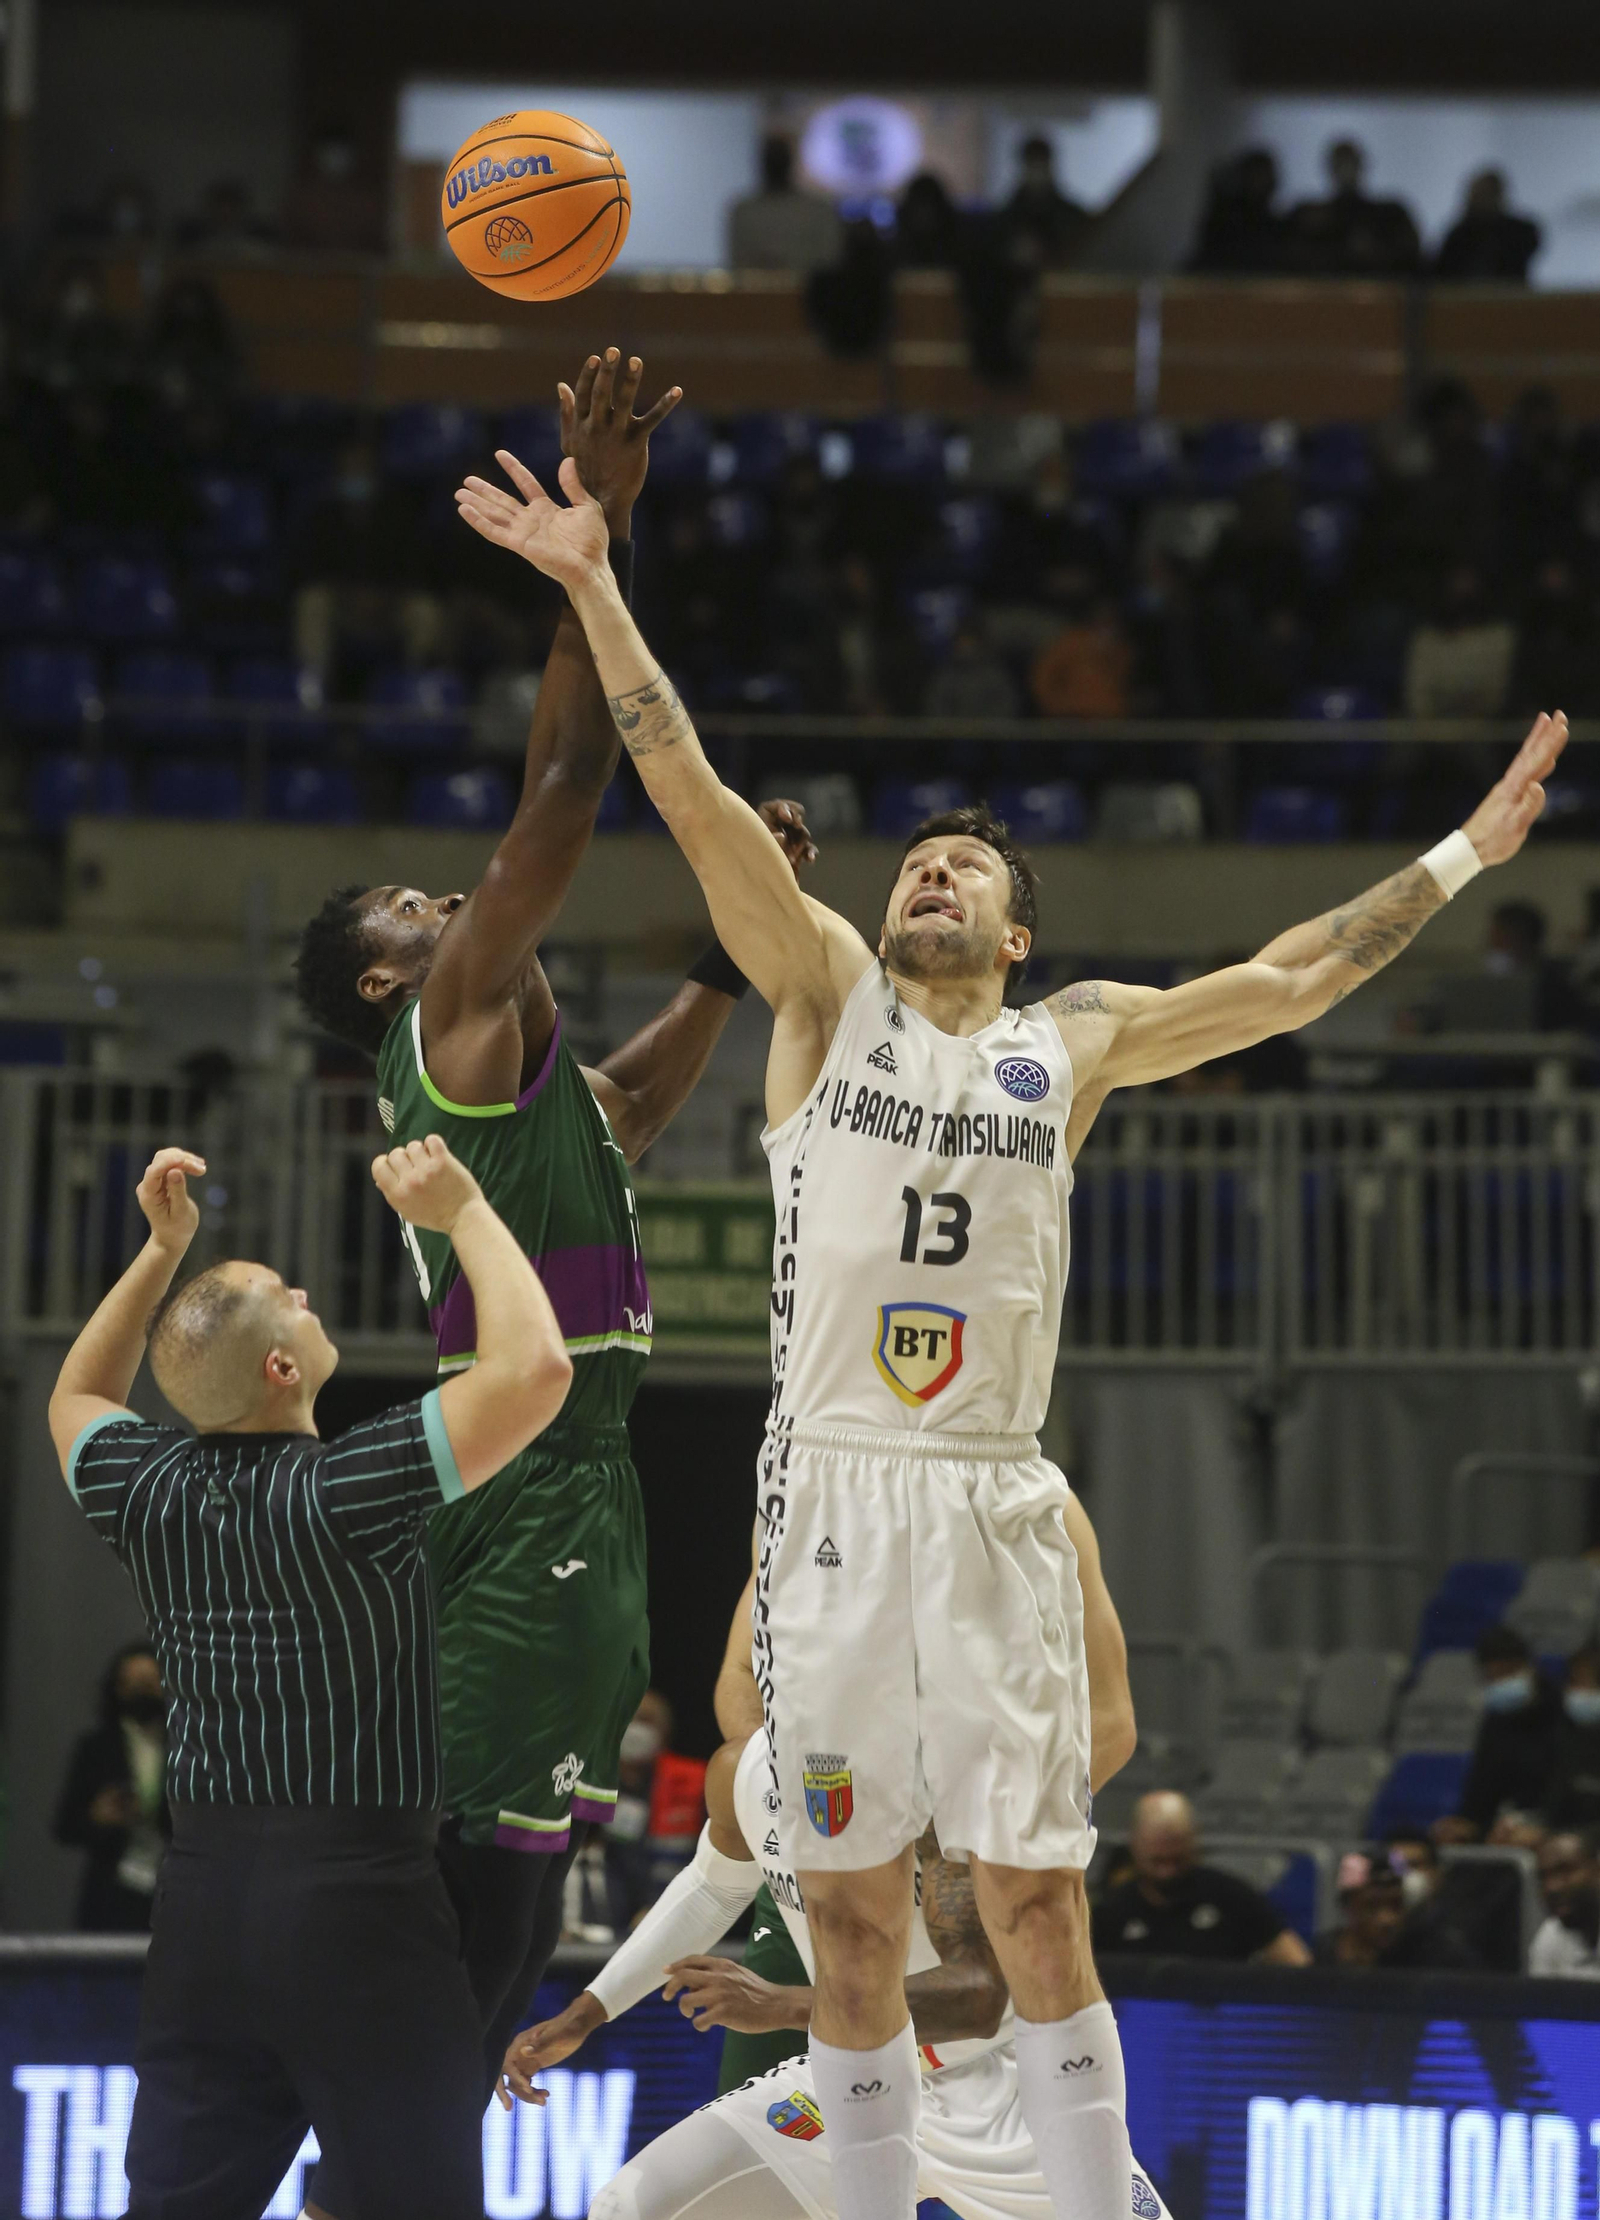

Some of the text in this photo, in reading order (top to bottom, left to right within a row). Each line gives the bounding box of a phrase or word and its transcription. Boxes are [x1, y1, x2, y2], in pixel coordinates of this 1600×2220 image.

[446, 154, 554, 209] Wilson
[533, 264, 586, 295] CHAMPIONS
[866, 1053, 899, 1076] PEAK
[830, 1079, 1056, 1171] U-BANCA TANSILVANIA
[899, 1185, 972, 1267] 13
[893, 1325, 947, 1361] BT
[814, 1556, 843, 1568] PEAK
[763, 1844, 779, 1857] PEA
